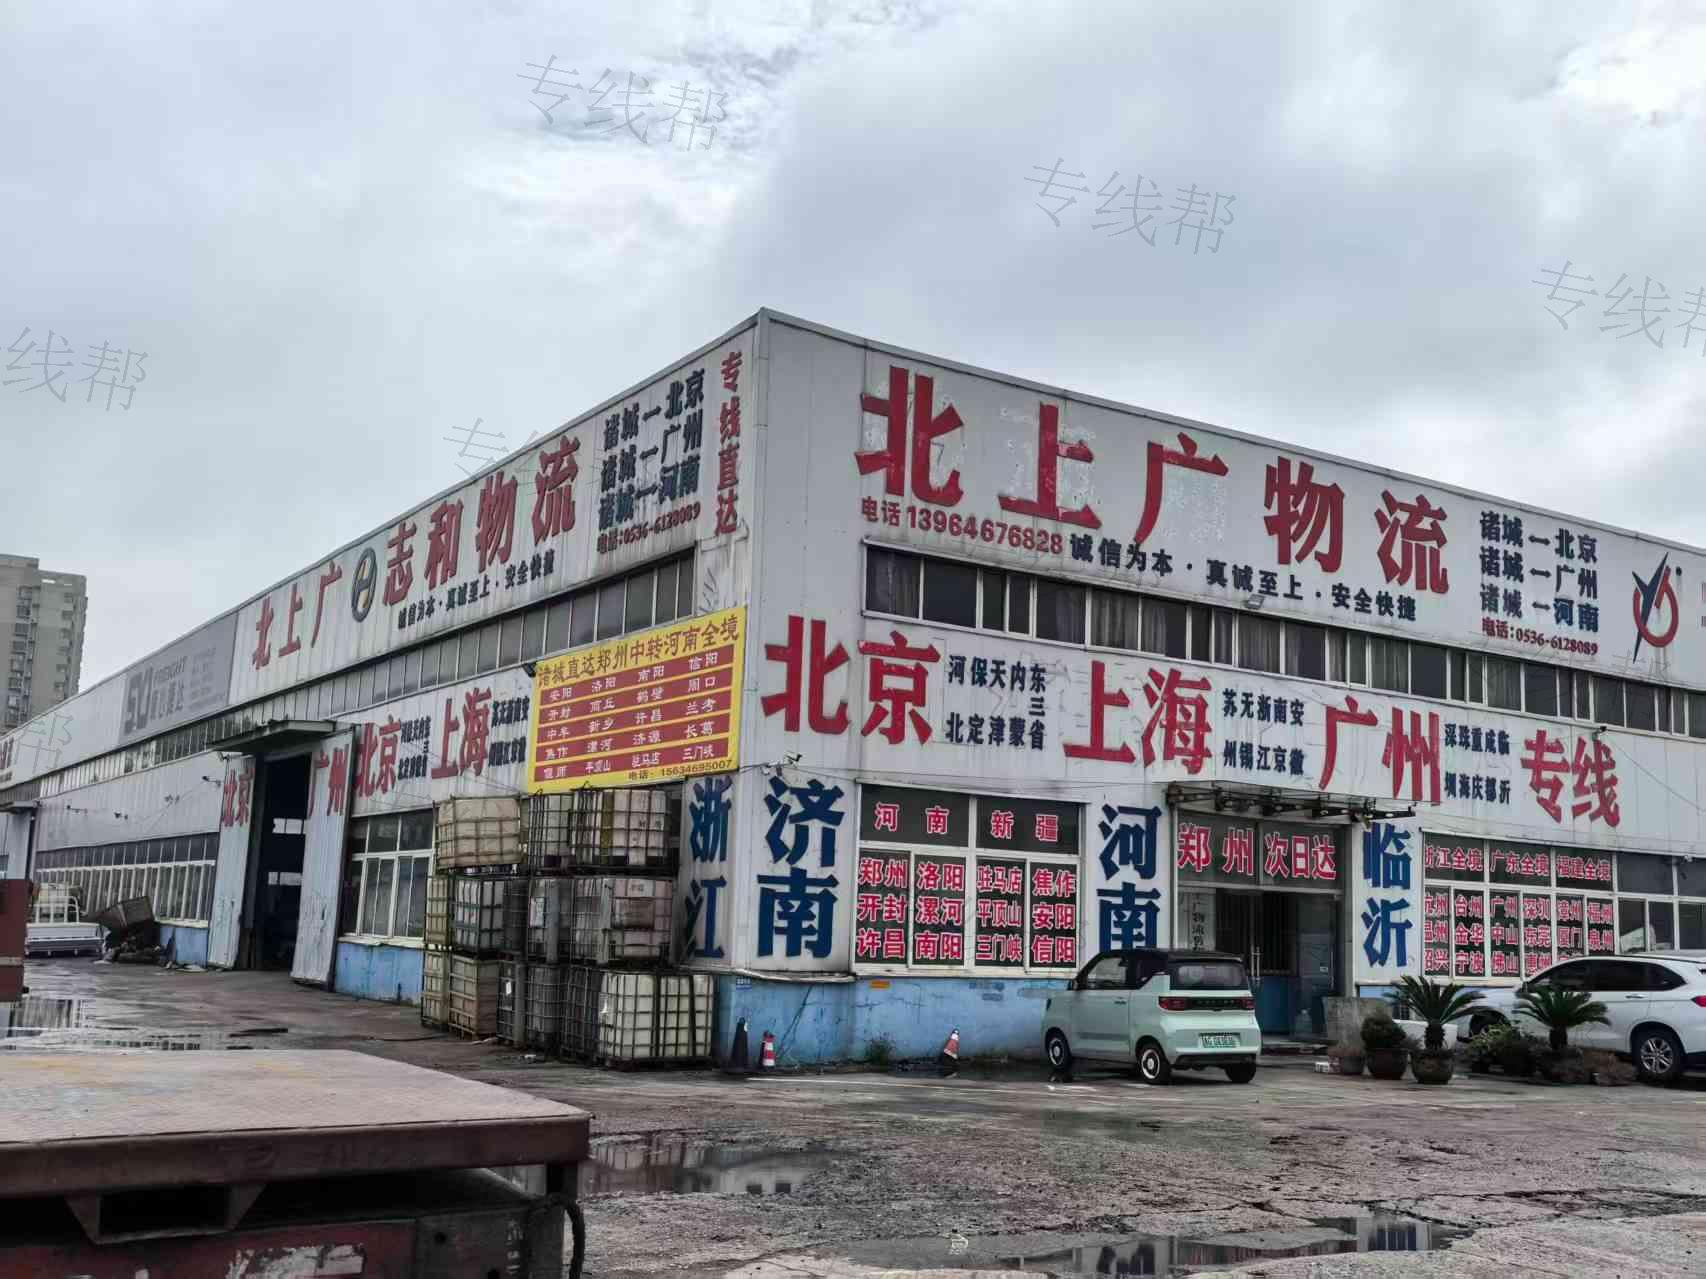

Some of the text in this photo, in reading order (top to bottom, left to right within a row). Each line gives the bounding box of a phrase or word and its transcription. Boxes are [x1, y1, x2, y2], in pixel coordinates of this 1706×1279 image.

[714, 352, 743, 536] 专线直达
[854, 366, 1449, 594] 北上广物流
[861, 496, 1064, 556] 电话 13964676828
[253, 561, 343, 670] 北上广
[760, 615, 941, 745] 北京
[431, 686, 493, 779] 上海
[1062, 660, 1215, 775] 上海
[353, 714, 401, 798] 北京
[1318, 695, 1441, 807] 广州
[1521, 729, 1620, 828] 专线
[874, 801, 950, 833] 河南
[990, 811, 1059, 842] 新疆
[685, 776, 733, 958] 浙江
[757, 776, 845, 958] 济南
[859, 857, 908, 888] 郑州
[917, 862, 964, 890] 洛阳
[1097, 804, 1162, 951] 河南
[1491, 850, 1549, 876] 广东全境
[976, 866, 1022, 895] 驻马店
[1032, 868, 1076, 898] 焦作
[1361, 822, 1413, 967] 临沂
[857, 894, 907, 922] 开封
[915, 896, 964, 925] 漯河
[976, 899, 1022, 927] 平顶山
[1033, 902, 1075, 929] 安阳
[1491, 895, 1518, 919] 广州
[857, 928, 905, 959] 许昌
[915, 930, 962, 960] 南阳
[976, 933, 1022, 961] 三门峡
[1491, 922, 1518, 945] 中山
[1032, 935, 1075, 964] 信阳
